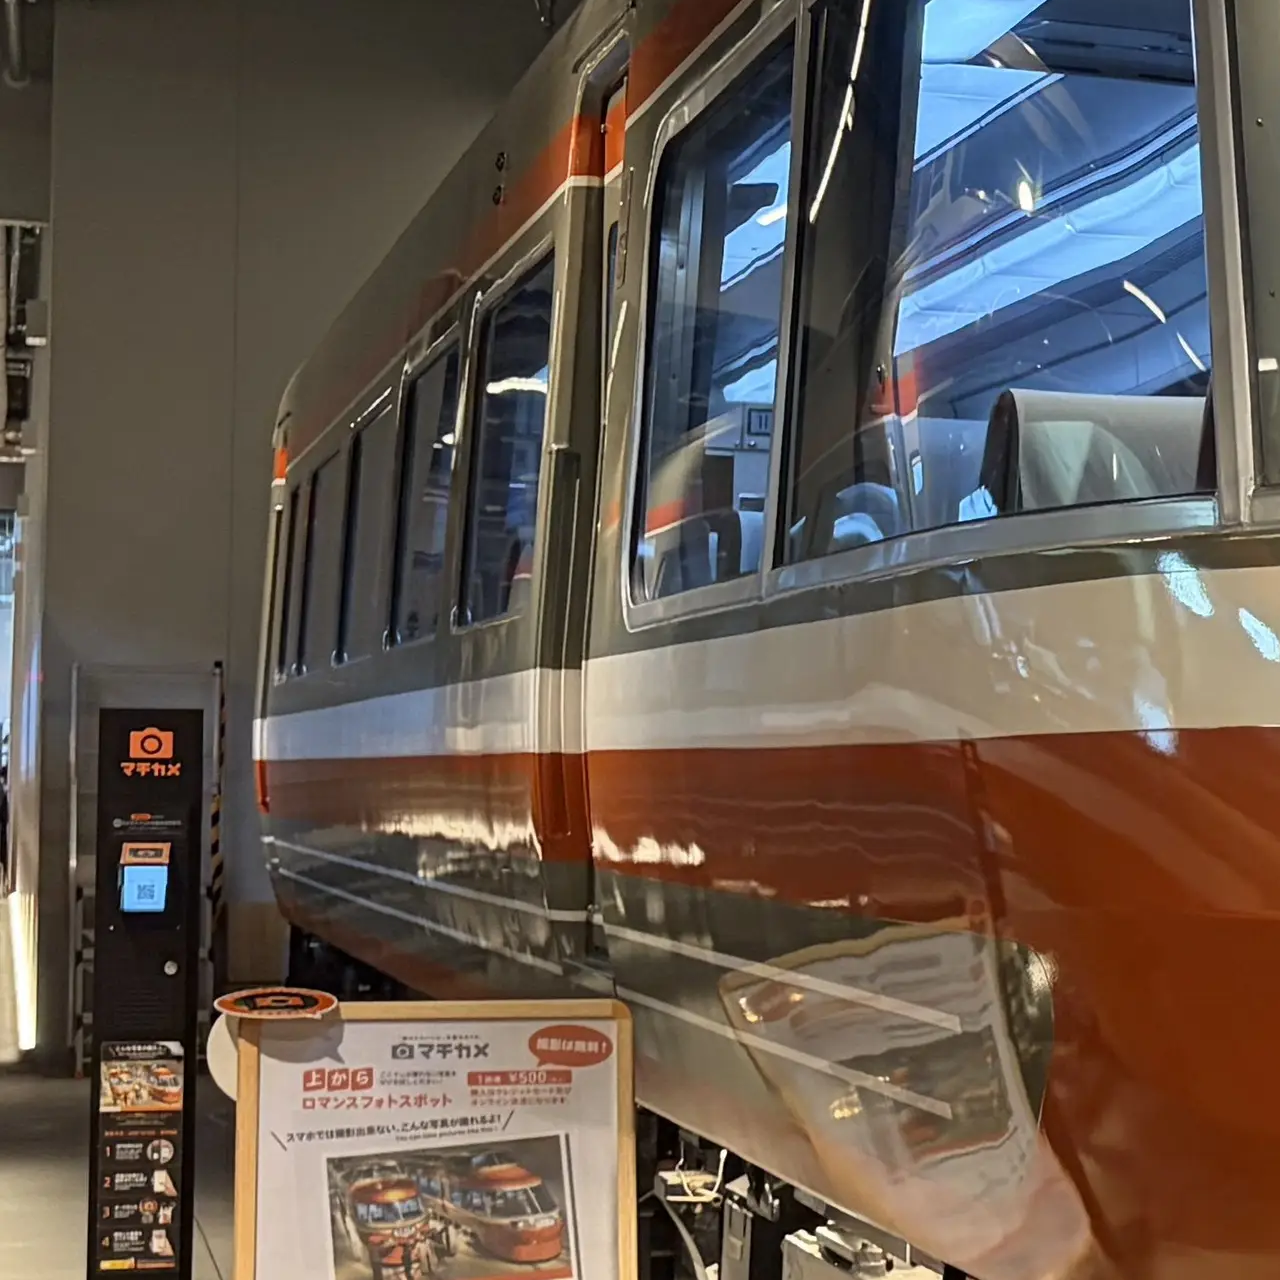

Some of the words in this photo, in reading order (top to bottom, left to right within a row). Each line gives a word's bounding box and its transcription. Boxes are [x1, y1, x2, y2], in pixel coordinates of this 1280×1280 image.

[120, 762, 181, 777] マチカメ
[418, 1042, 490, 1060] マチカメ
[305, 1070, 369, 1088] 上から
[302, 1092, 453, 1110] ロマンスフォトスポット
